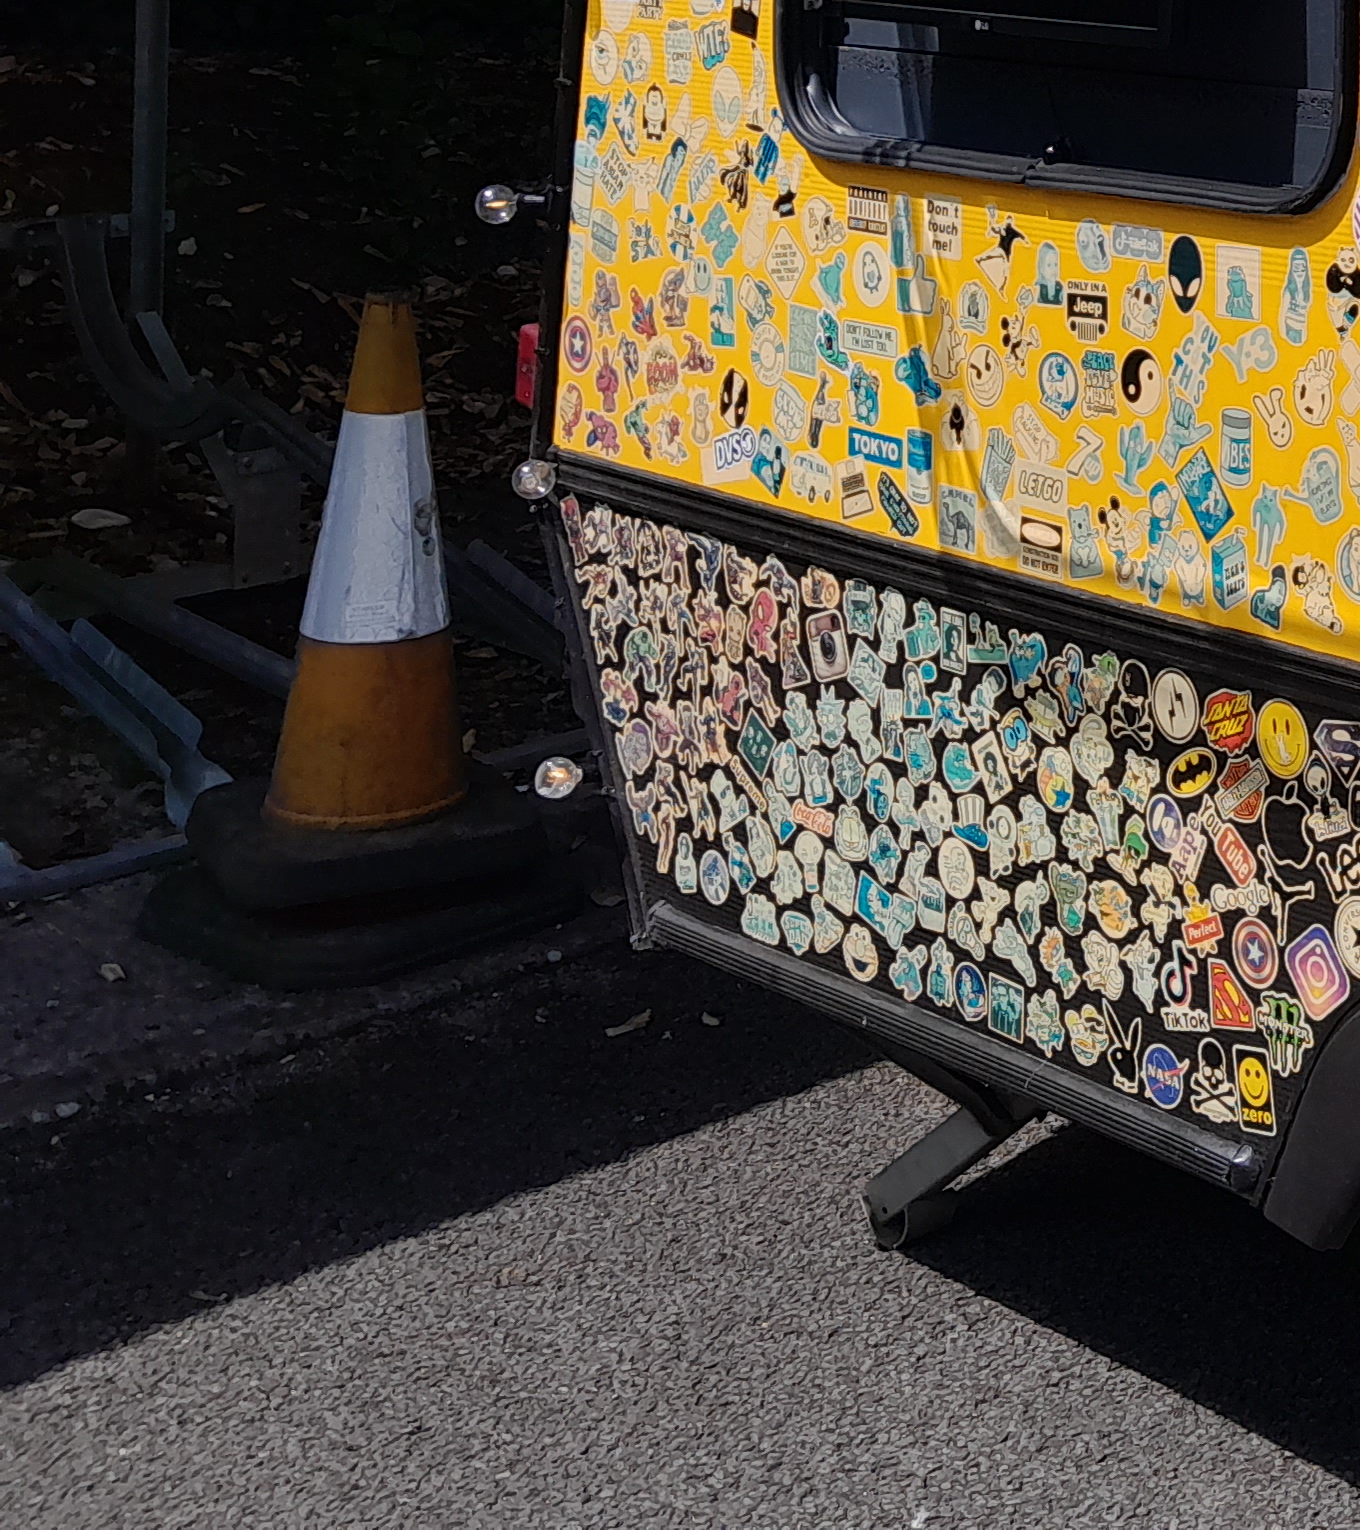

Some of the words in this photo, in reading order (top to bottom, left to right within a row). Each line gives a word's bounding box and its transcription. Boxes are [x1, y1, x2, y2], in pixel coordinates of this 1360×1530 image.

[928, 221, 958, 235] touch
[1073, 296, 1103, 317] Jeep
[714, 438, 744, 470] DVS
[852, 433, 899, 461] TOKYO
[1165, 1012, 1209, 1030] TikTok
[1242, 1107, 1272, 1126] zero
